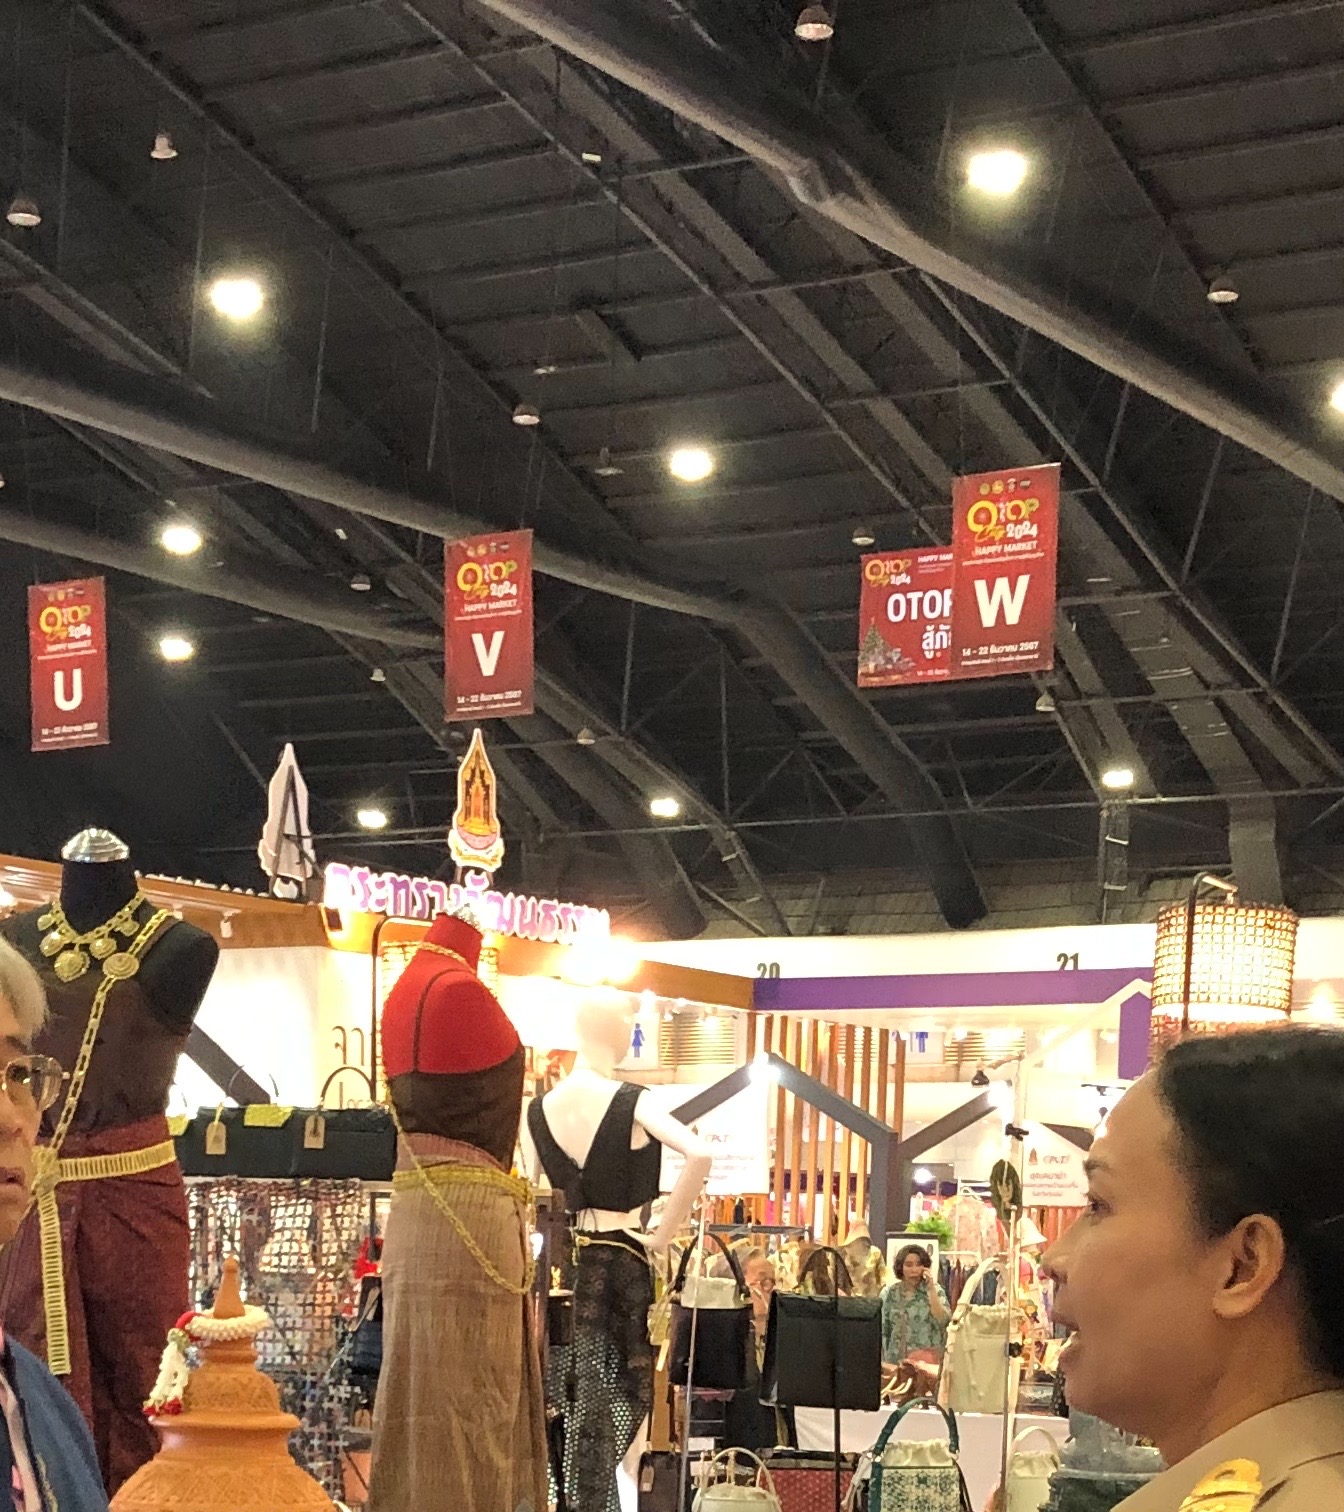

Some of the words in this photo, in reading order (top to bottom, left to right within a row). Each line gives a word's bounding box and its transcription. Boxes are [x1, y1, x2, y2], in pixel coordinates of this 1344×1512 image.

[1007, 521, 1038, 539] 2024
[975, 543, 1002, 555] HAPPY
[1003, 541, 1037, 553] MARKET
[974, 574, 1030, 628] W
[471, 631, 505, 676] V
[962, 648, 971, 656] 14
[978, 646, 989, 655] 22
[54, 668, 83, 712] U
[1057, 953, 1080, 971] 21
[757, 963, 781, 980] 20
